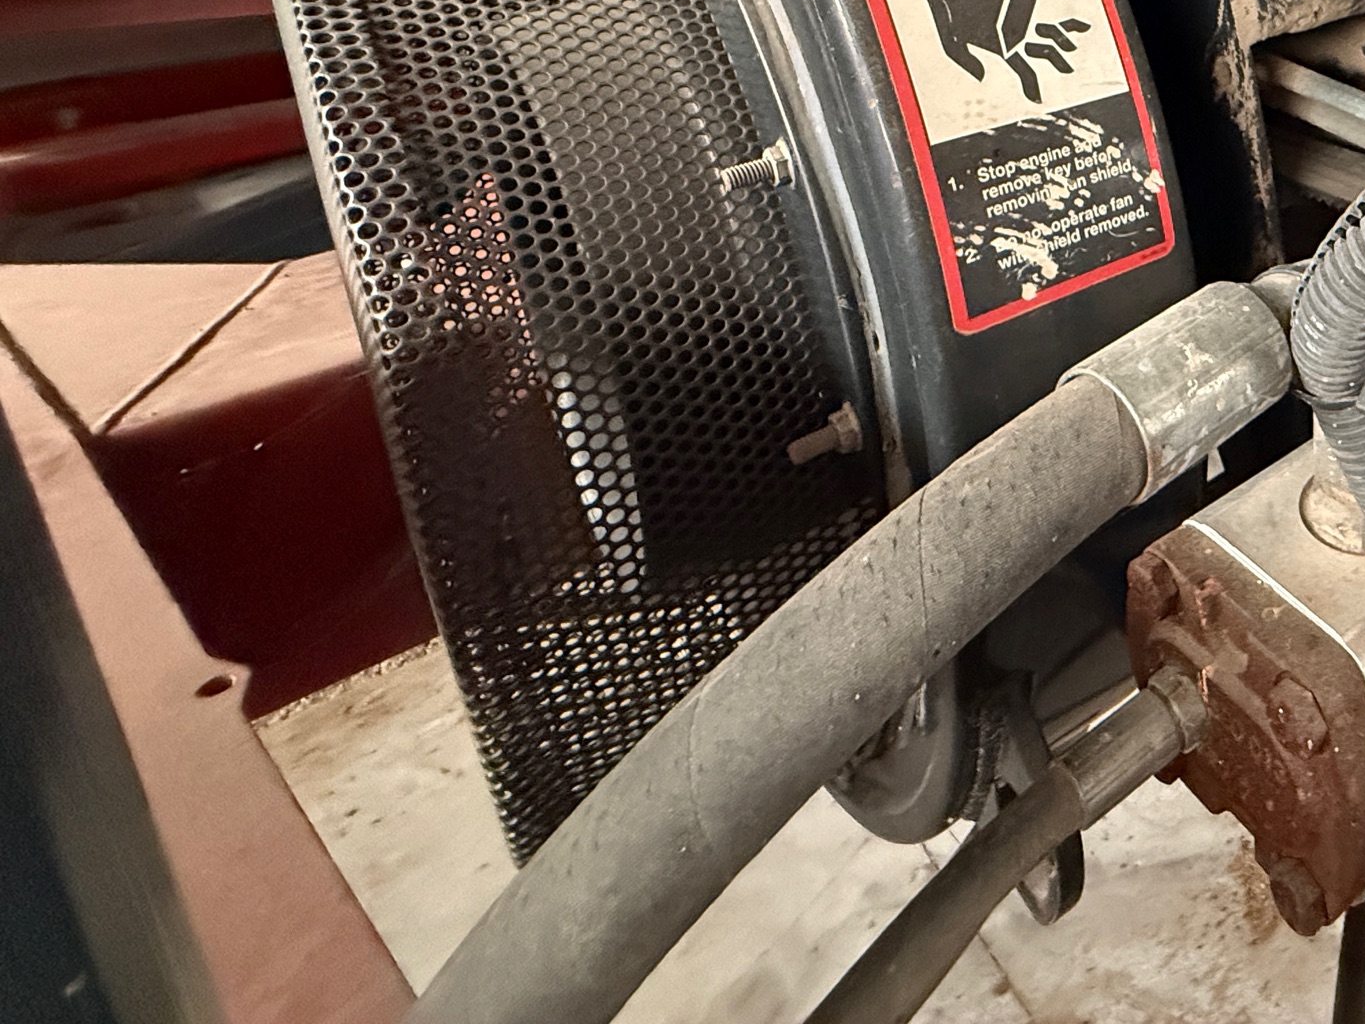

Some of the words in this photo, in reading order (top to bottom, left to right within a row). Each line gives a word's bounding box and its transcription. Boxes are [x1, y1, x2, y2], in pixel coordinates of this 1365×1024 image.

[947, 176, 964, 192] 1.
[977, 160, 1016, 183] Stop
[1019, 147, 1071, 168] engine
[982, 172, 1041, 201] remove
[1044, 163, 1071, 180] key
[1074, 146, 1121, 171] befor
[986, 184, 1062, 218] removin
[1051, 204, 1107, 232] operate
[1110, 194, 1134, 212] fan
[997, 246, 1034, 270] wit
[1084, 204, 1150, 238] removed.
